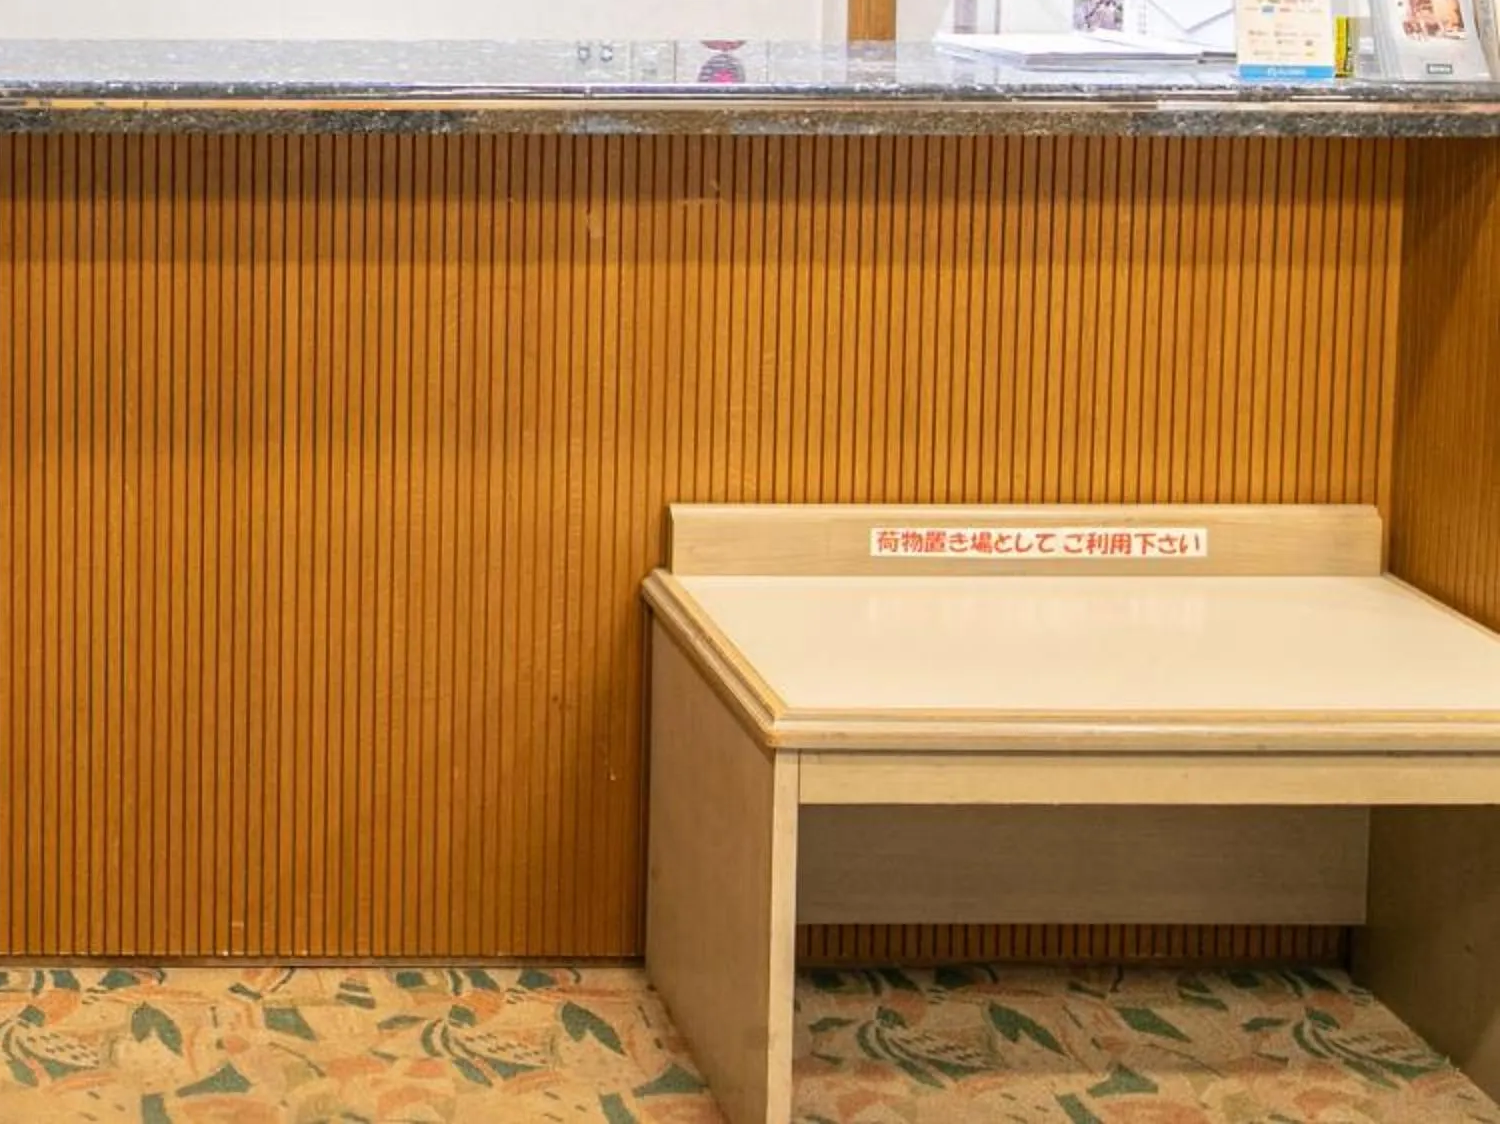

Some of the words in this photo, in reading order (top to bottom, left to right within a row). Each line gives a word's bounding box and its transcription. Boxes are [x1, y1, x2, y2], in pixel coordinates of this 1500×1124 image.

[875, 530, 1201, 556] 荷物置き場としてご利用下さい
